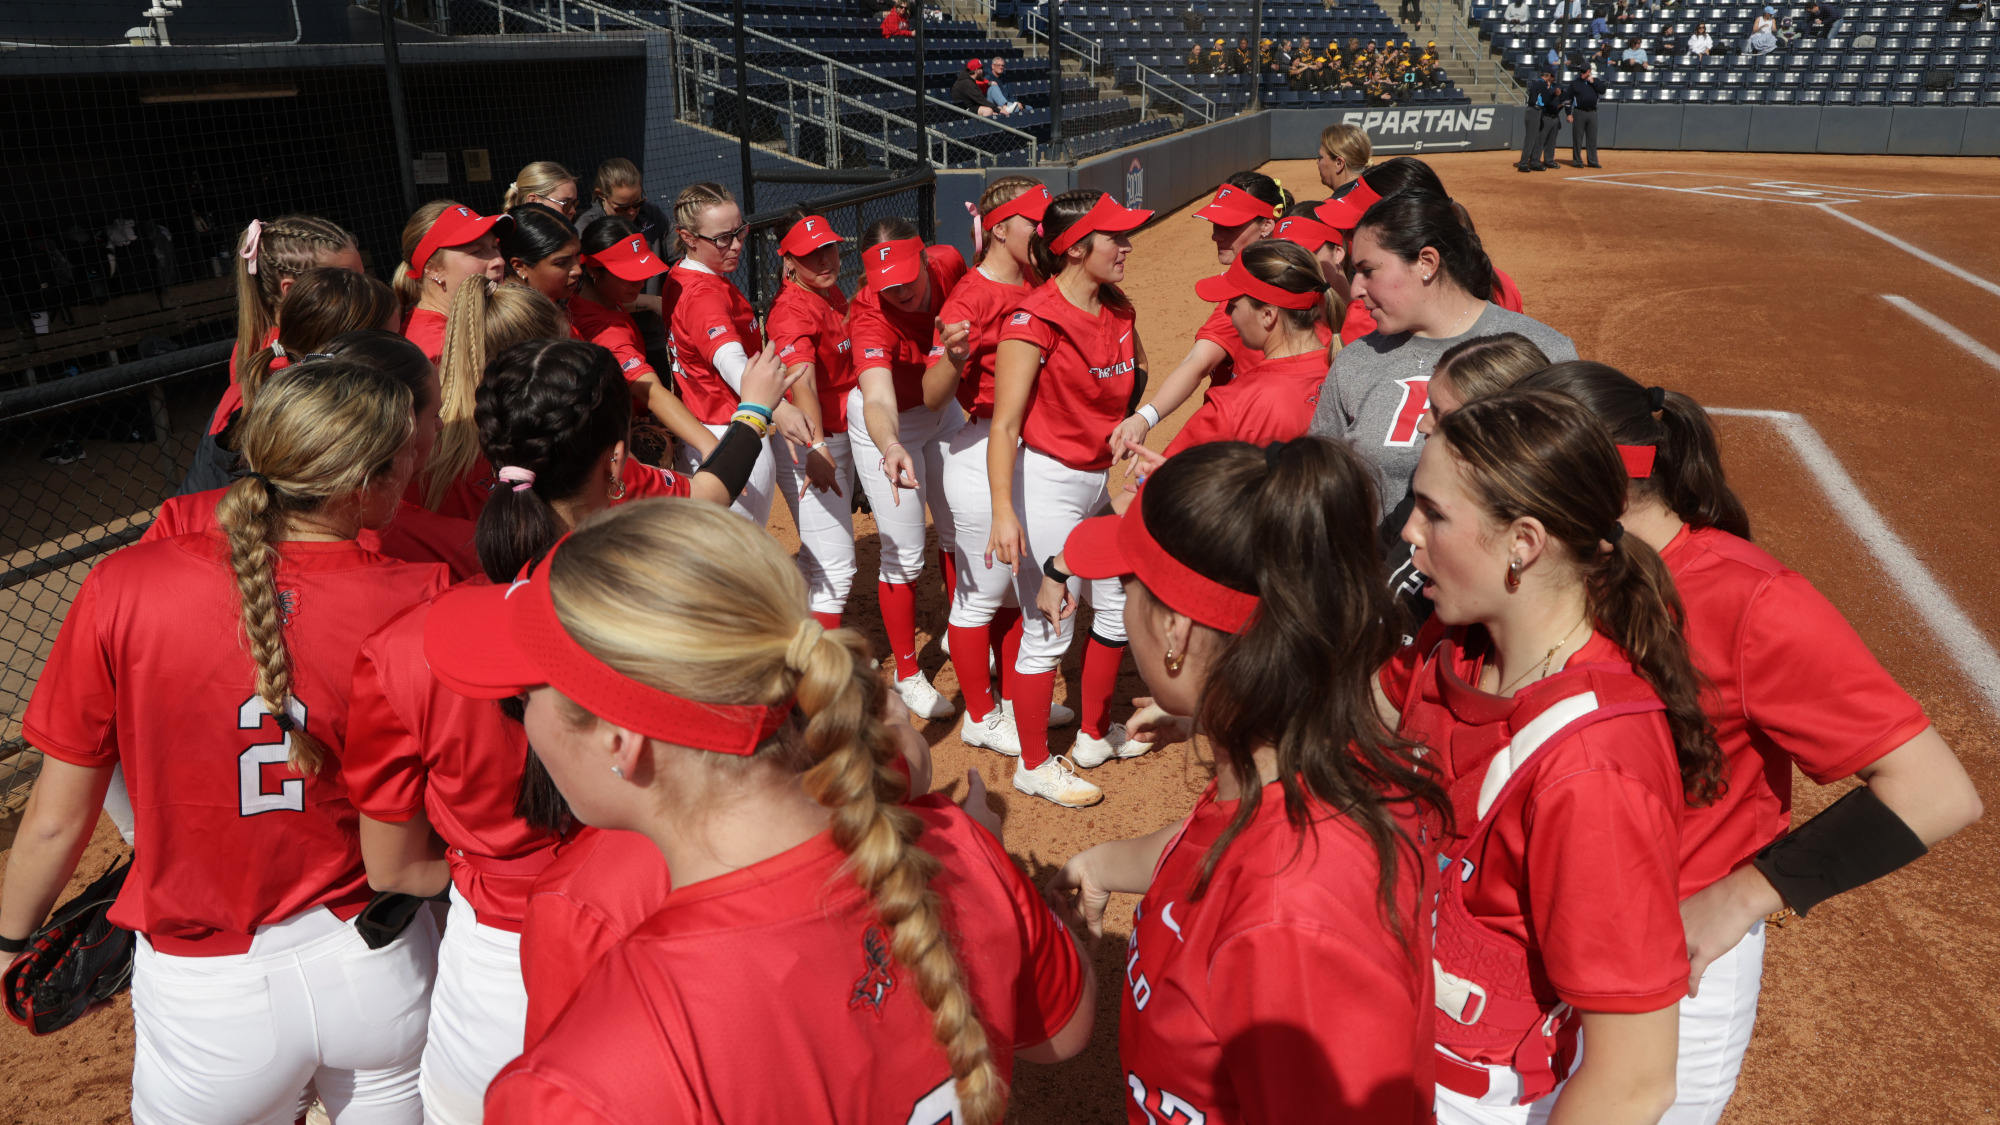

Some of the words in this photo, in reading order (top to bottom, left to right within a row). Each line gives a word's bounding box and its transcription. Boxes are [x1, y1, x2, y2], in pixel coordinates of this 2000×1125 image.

[1342, 107, 1495, 135] SPARTANS
[1218, 188, 1232, 199] F
[456, 206, 469, 217] F
[805, 219, 816, 232] F
[1279, 220, 1293, 233] F
[631, 238, 641, 253] F
[879, 246, 892, 261] F
[238, 692, 308, 817] 2
